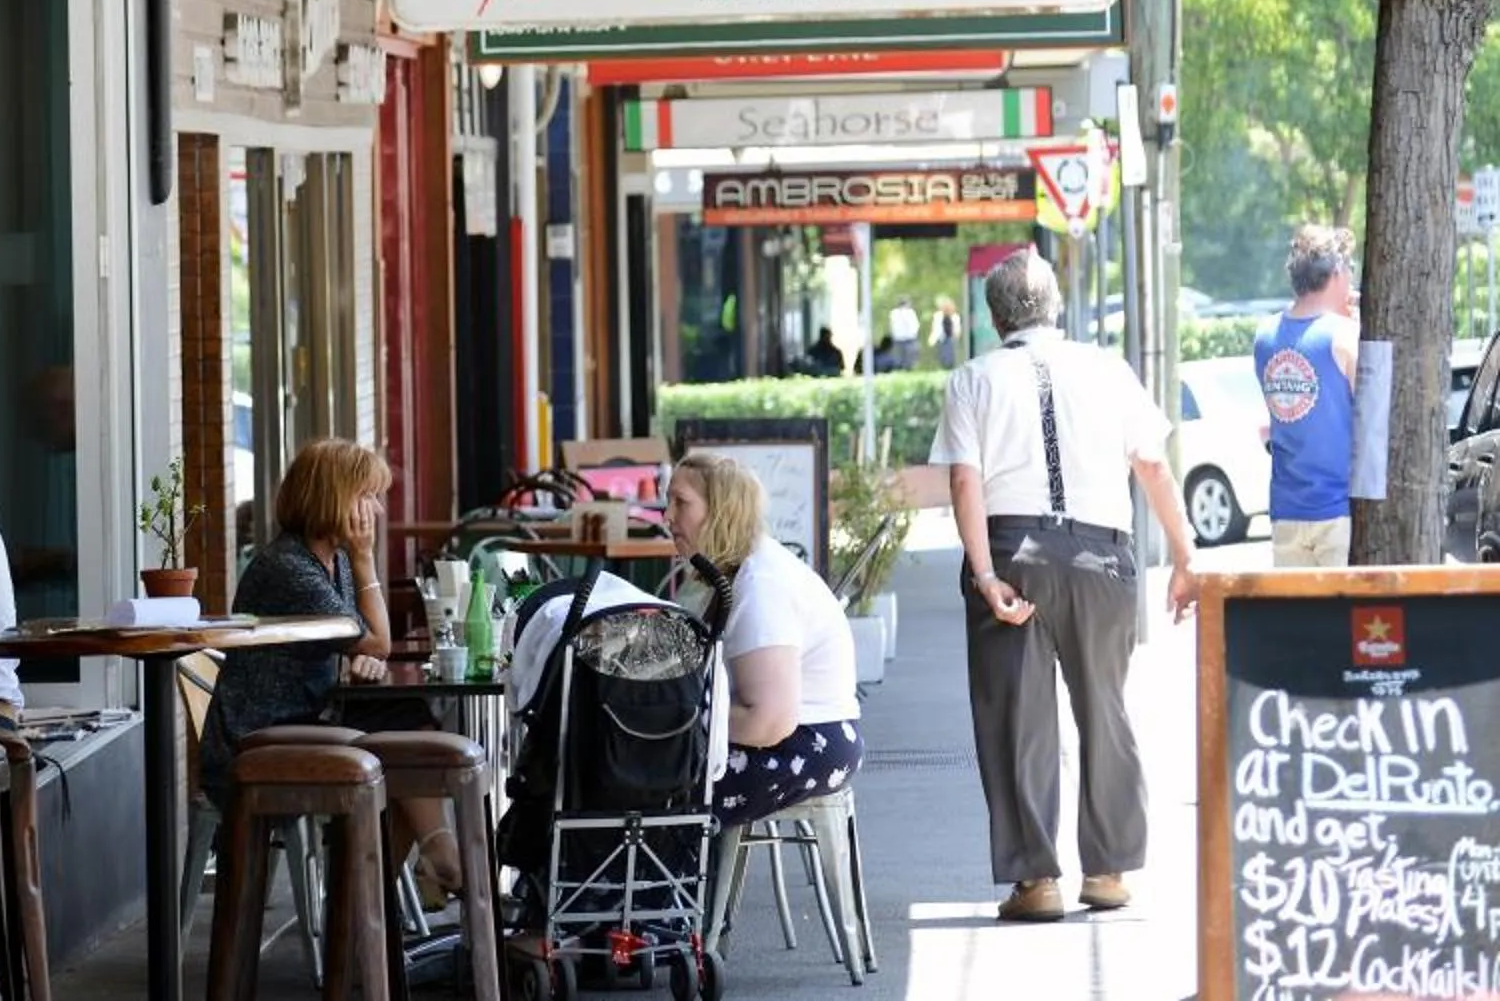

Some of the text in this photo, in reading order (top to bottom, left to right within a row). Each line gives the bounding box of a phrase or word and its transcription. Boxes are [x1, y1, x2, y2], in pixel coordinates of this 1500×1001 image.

[737, 101, 940, 141] Seahorse
[715, 173, 955, 208] AMBROSIA
[1250, 689, 1392, 754] Check
[1236, 749, 1290, 797] at
[1303, 752, 1378, 801] Del
[1235, 800, 1308, 844] and
[1241, 851, 1340, 925] $20
[1244, 919, 1350, 986] $12
